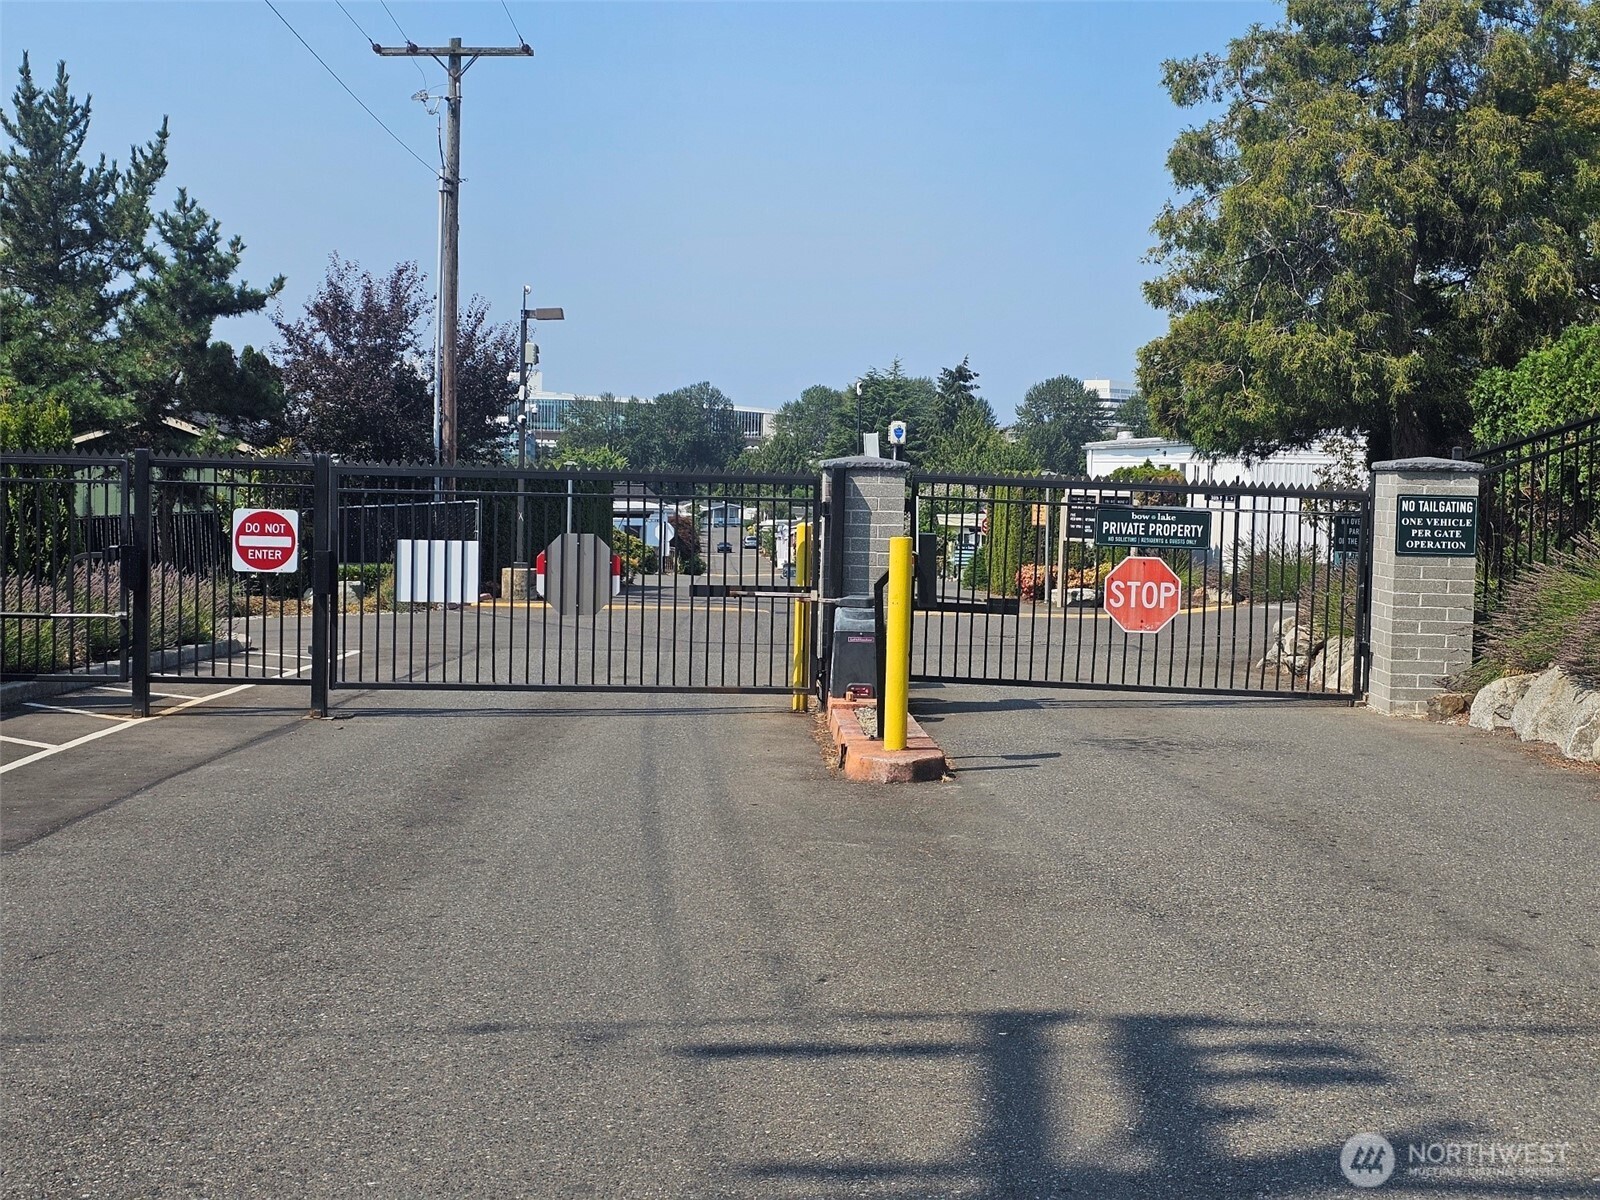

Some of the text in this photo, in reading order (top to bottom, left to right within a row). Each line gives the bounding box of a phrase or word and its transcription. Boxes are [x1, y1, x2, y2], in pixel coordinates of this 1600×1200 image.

[1401, 500, 1474, 513] NO TAILGATING
[1131, 512, 1177, 521] bow lake
[1401, 517, 1473, 527] ONE VEHICLE
[245, 522, 286, 534] DO NOT
[1102, 521, 1146, 535] PRIVATE
[1148, 523, 1204, 538] PROPERTY
[1411, 529, 1462, 538] PER GATE
[1405, 540, 1467, 549] OPERATION
[248, 549, 282, 560] ENTER
[1109, 580, 1176, 609] STOP
